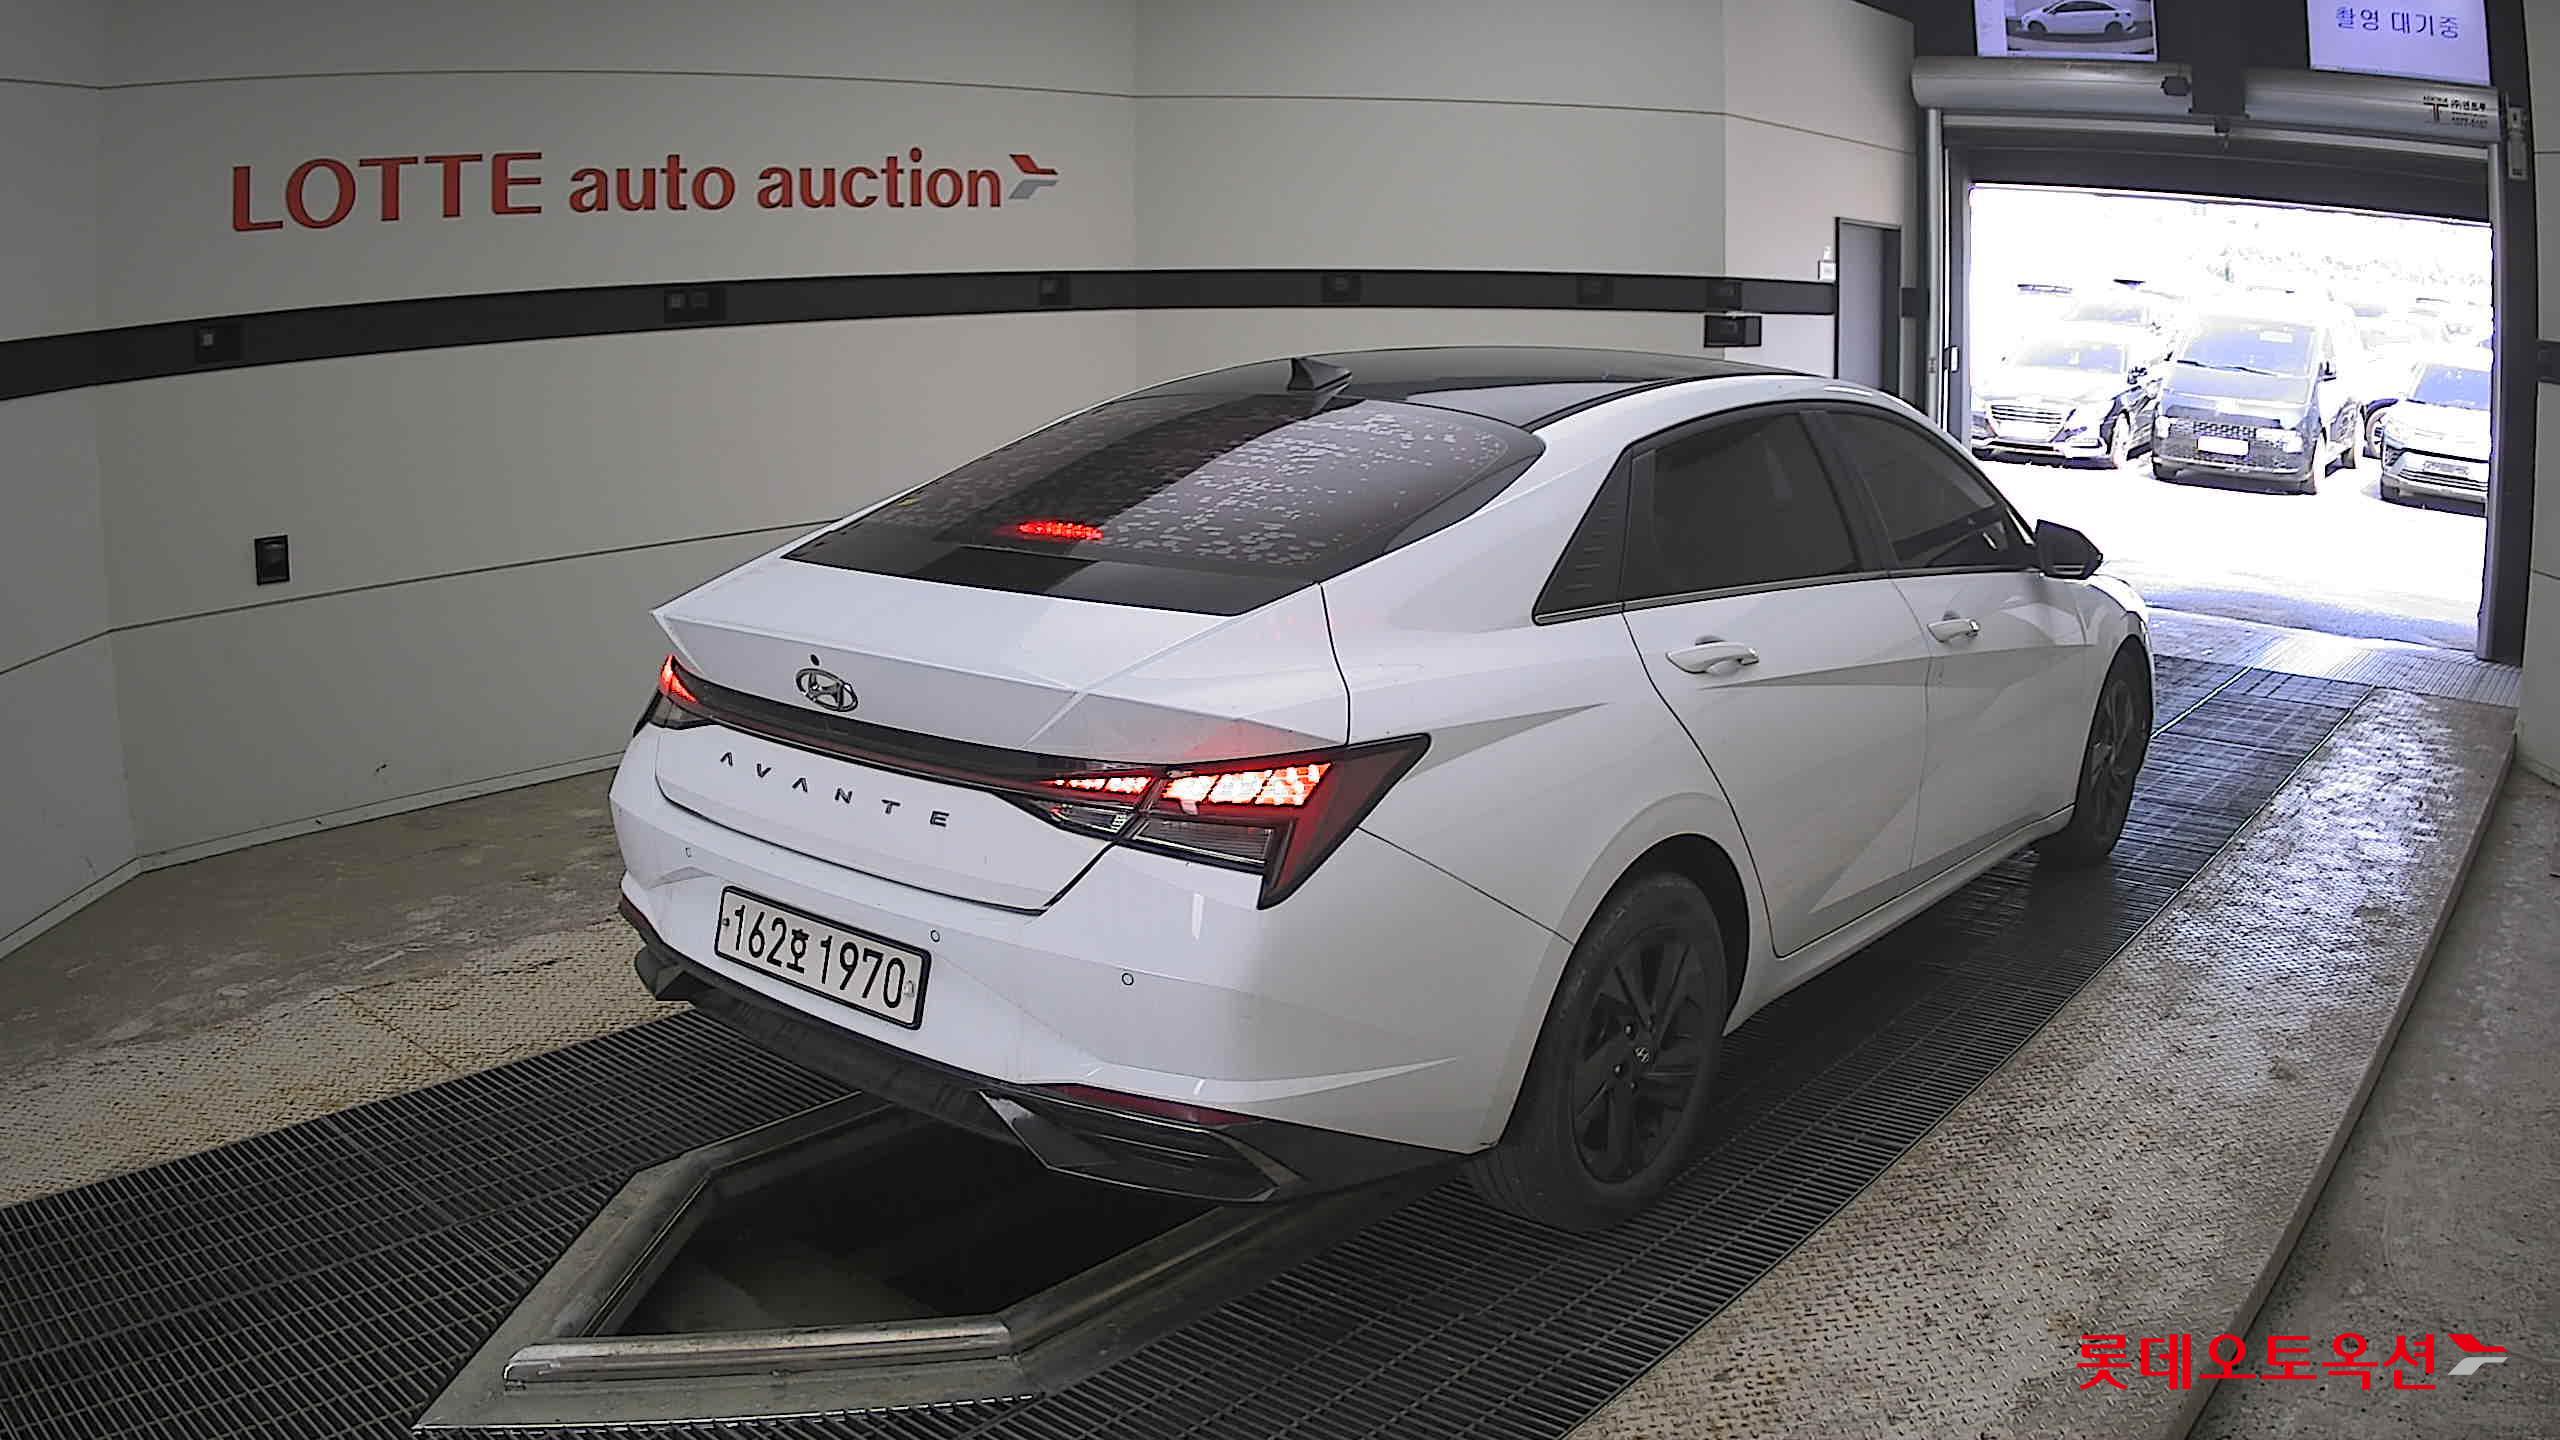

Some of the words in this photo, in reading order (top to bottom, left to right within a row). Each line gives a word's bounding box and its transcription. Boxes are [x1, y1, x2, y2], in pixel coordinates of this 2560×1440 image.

[2336, 7, 2380, 31] 촬영
[2391, 12, 2459, 39] 대기중
[232, 152, 542, 232] LOTTE
[568, 153, 736, 213] auto
[756, 146, 1001, 210] auction
[720, 751, 950, 828] AVANTE
